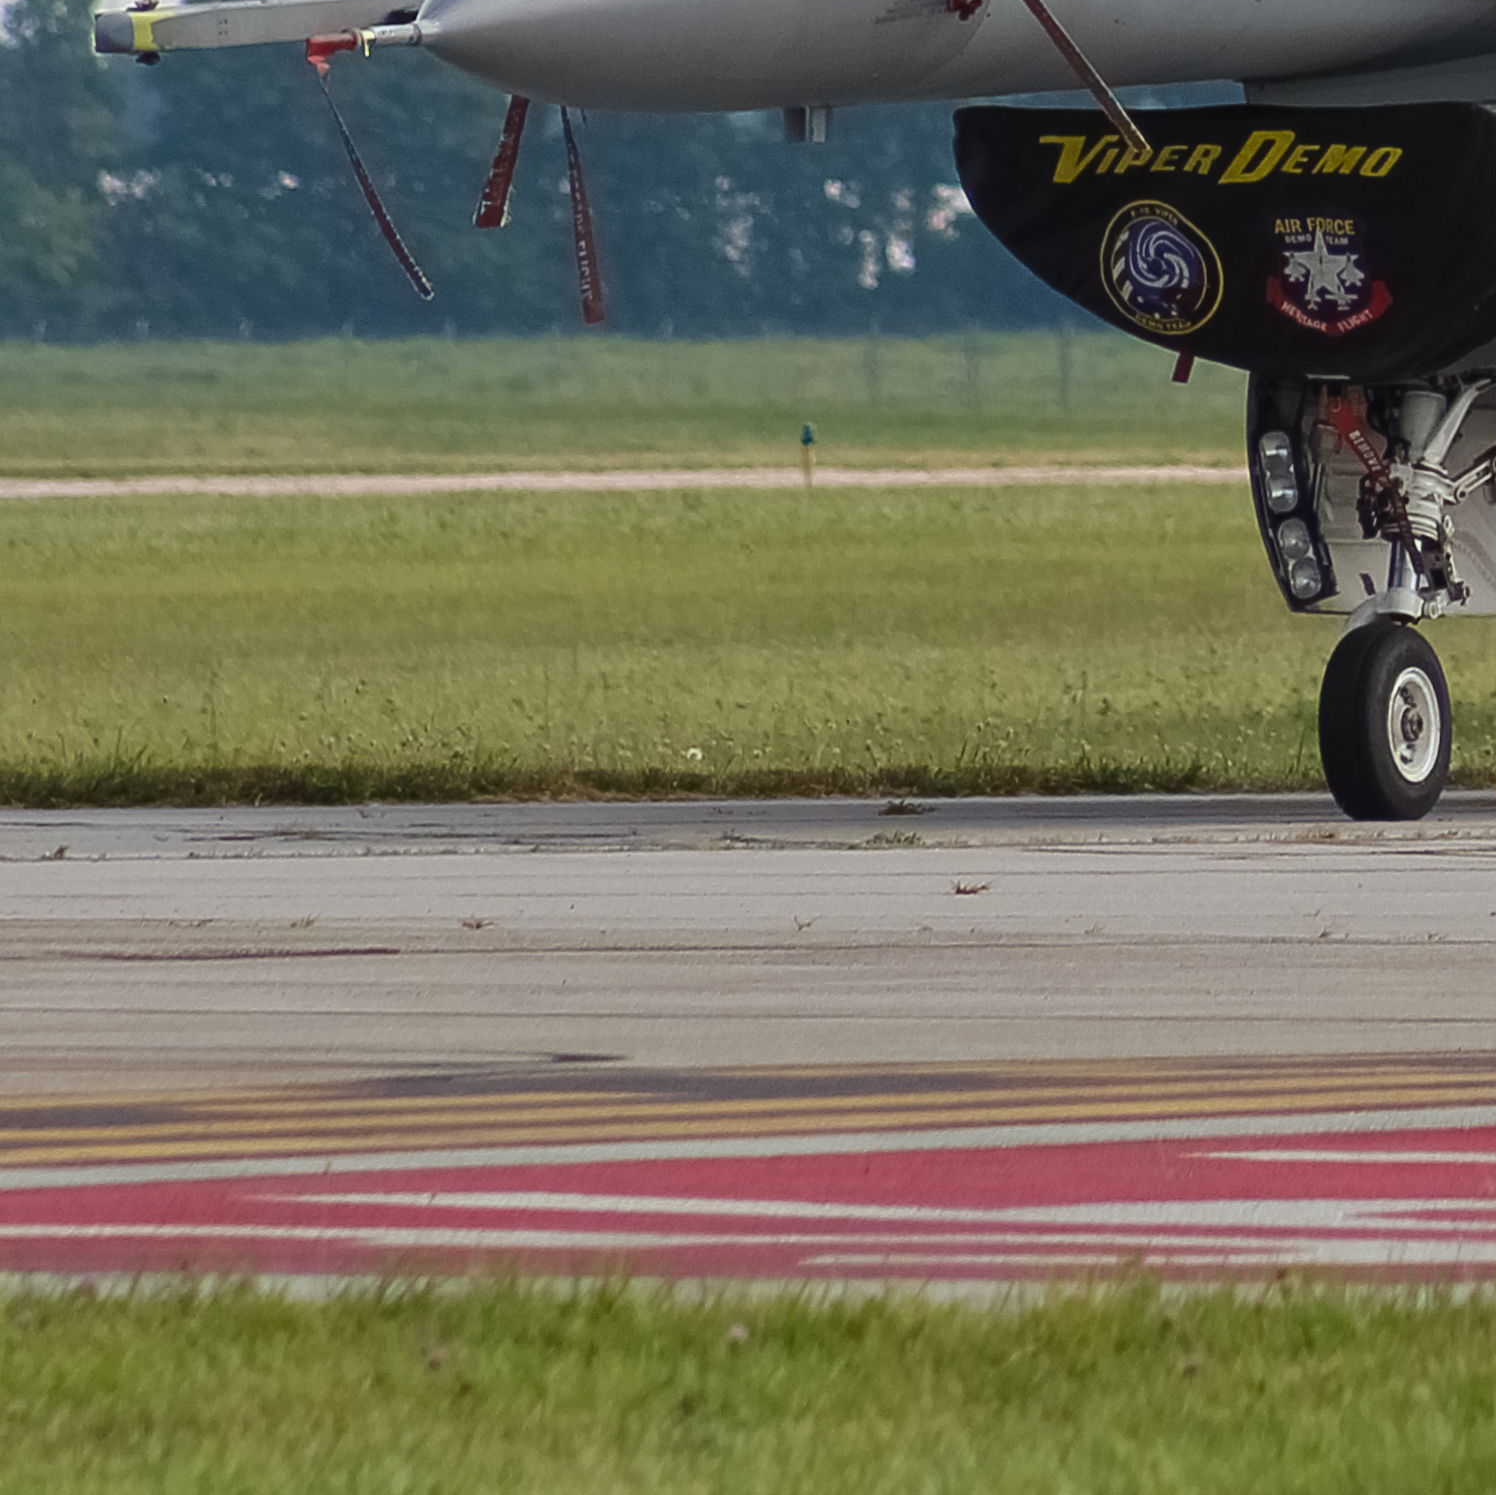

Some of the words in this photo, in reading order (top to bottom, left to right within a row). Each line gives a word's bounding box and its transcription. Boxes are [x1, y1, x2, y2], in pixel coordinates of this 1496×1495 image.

[1039, 134, 1221, 184] VIPER
[1218, 130, 1403, 184] DEMO
[1274, 218, 1302, 235] AIR
[1306, 217, 1355, 235] FORCE
[1284, 234, 1312, 244] DEMO
[1325, 235, 1349, 245] TEAM
[1280, 301, 1328, 332] HERITAGE
[1337, 308, 1373, 333] FLIGHT
